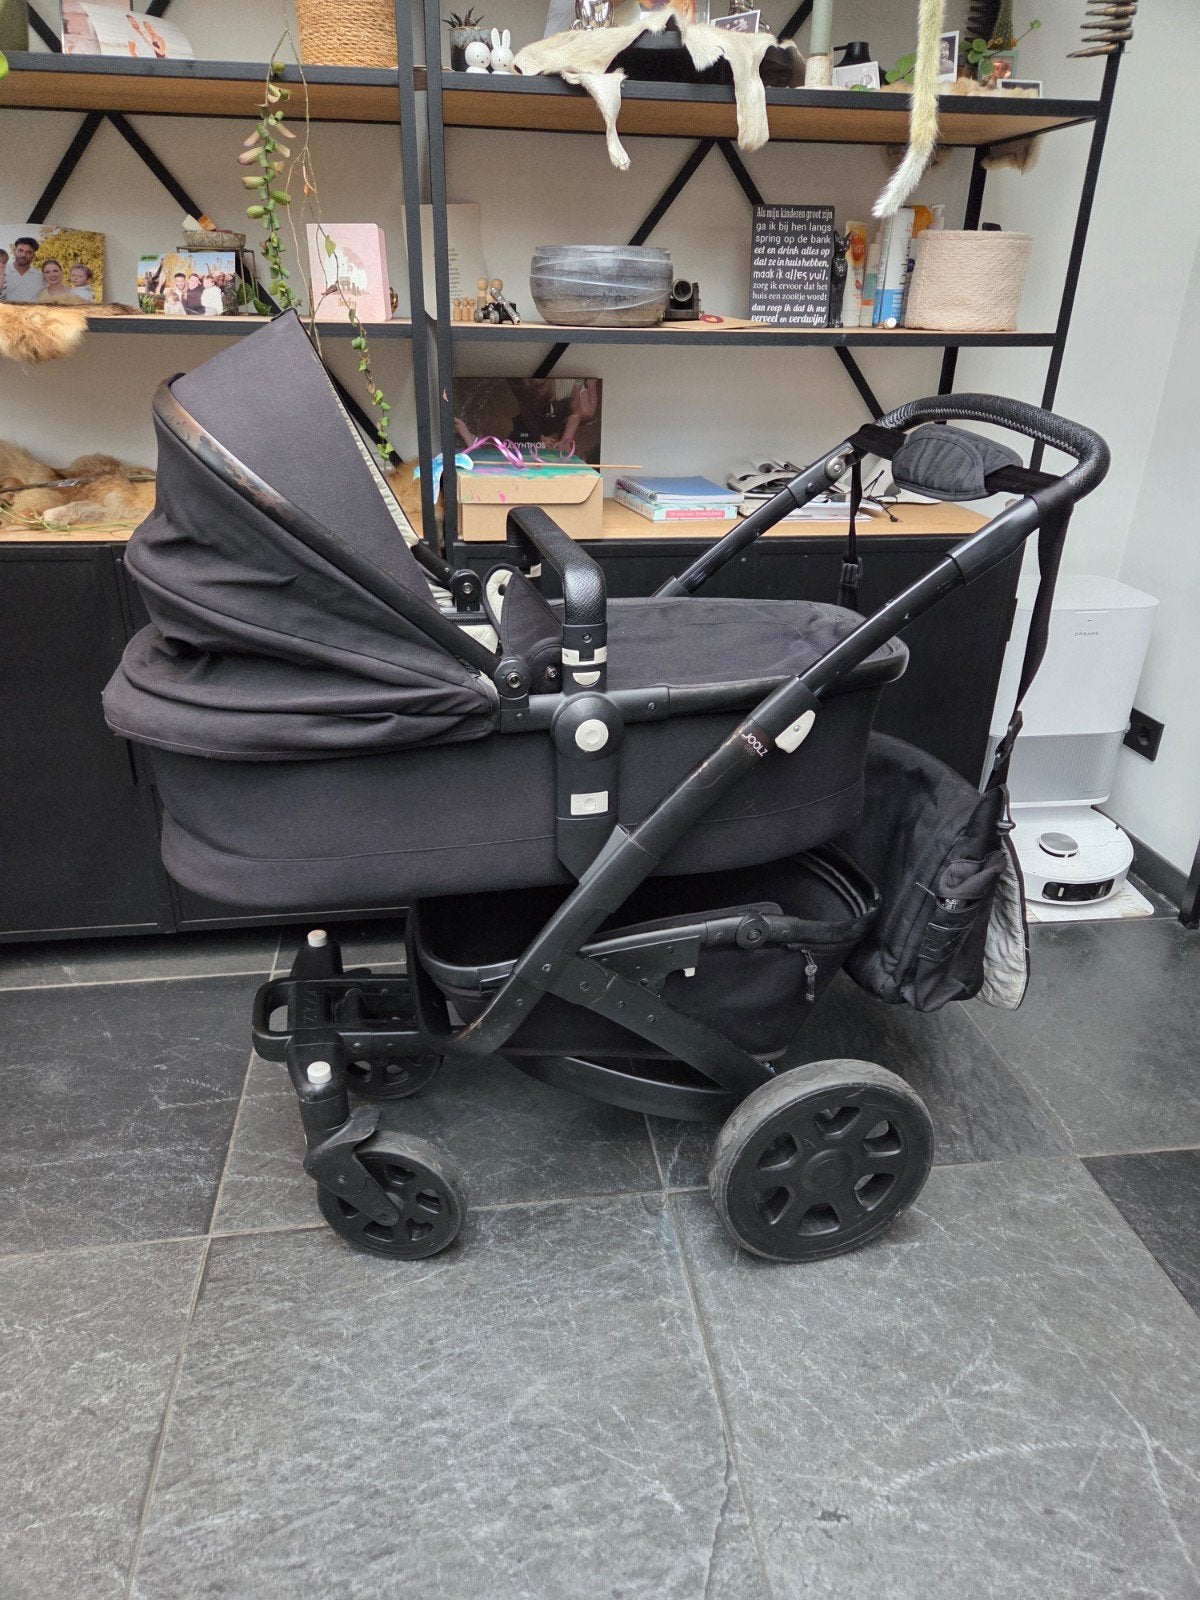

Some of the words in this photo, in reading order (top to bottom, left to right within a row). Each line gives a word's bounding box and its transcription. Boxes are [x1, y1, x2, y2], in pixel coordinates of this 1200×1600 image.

[756, 206, 766, 217] Als
[766, 208, 779, 220] mijn
[780, 208, 805, 218] kinderen
[806, 209, 821, 220] groot
[822, 209, 832, 221] zijn
[756, 223, 766, 232] ga
[769, 221, 776, 230] ik
[779, 222, 788, 232] bij
[792, 222, 806, 231] hen
[809, 222, 832, 233] langs
[755, 234, 780, 244] spring
[784, 236, 795, 245] op
[798, 234, 808, 243] de
[811, 235, 831, 243] bank
[754, 246, 765, 254] eet
[778, 246, 798, 255] drink
[801, 246, 819, 255] alles
[821, 248, 830, 258] op
[754, 257, 767, 266] dat
[777, 258, 784, 266] in
[785, 258, 801, 266] huis
[801, 258, 829, 268] hebben,
[753, 268, 774, 279] maak
[776, 269, 783, 279] ik
[753, 283, 768, 291] zorg
[770, 281, 777, 289] ik
[804, 282, 815, 290] dat
[817, 282, 828, 290] het
[753, 291, 767, 300] huis
[782, 293, 805, 302] zooitje
[752, 303, 765, 312] dan
[767, 305, 782, 313] roep
[784, 304, 791, 312] ik
[751, 314, 778, 322] verveel
[789, 314, 826, 326] verdwijn!
[740, 732, 768, 757] JOOLZ
